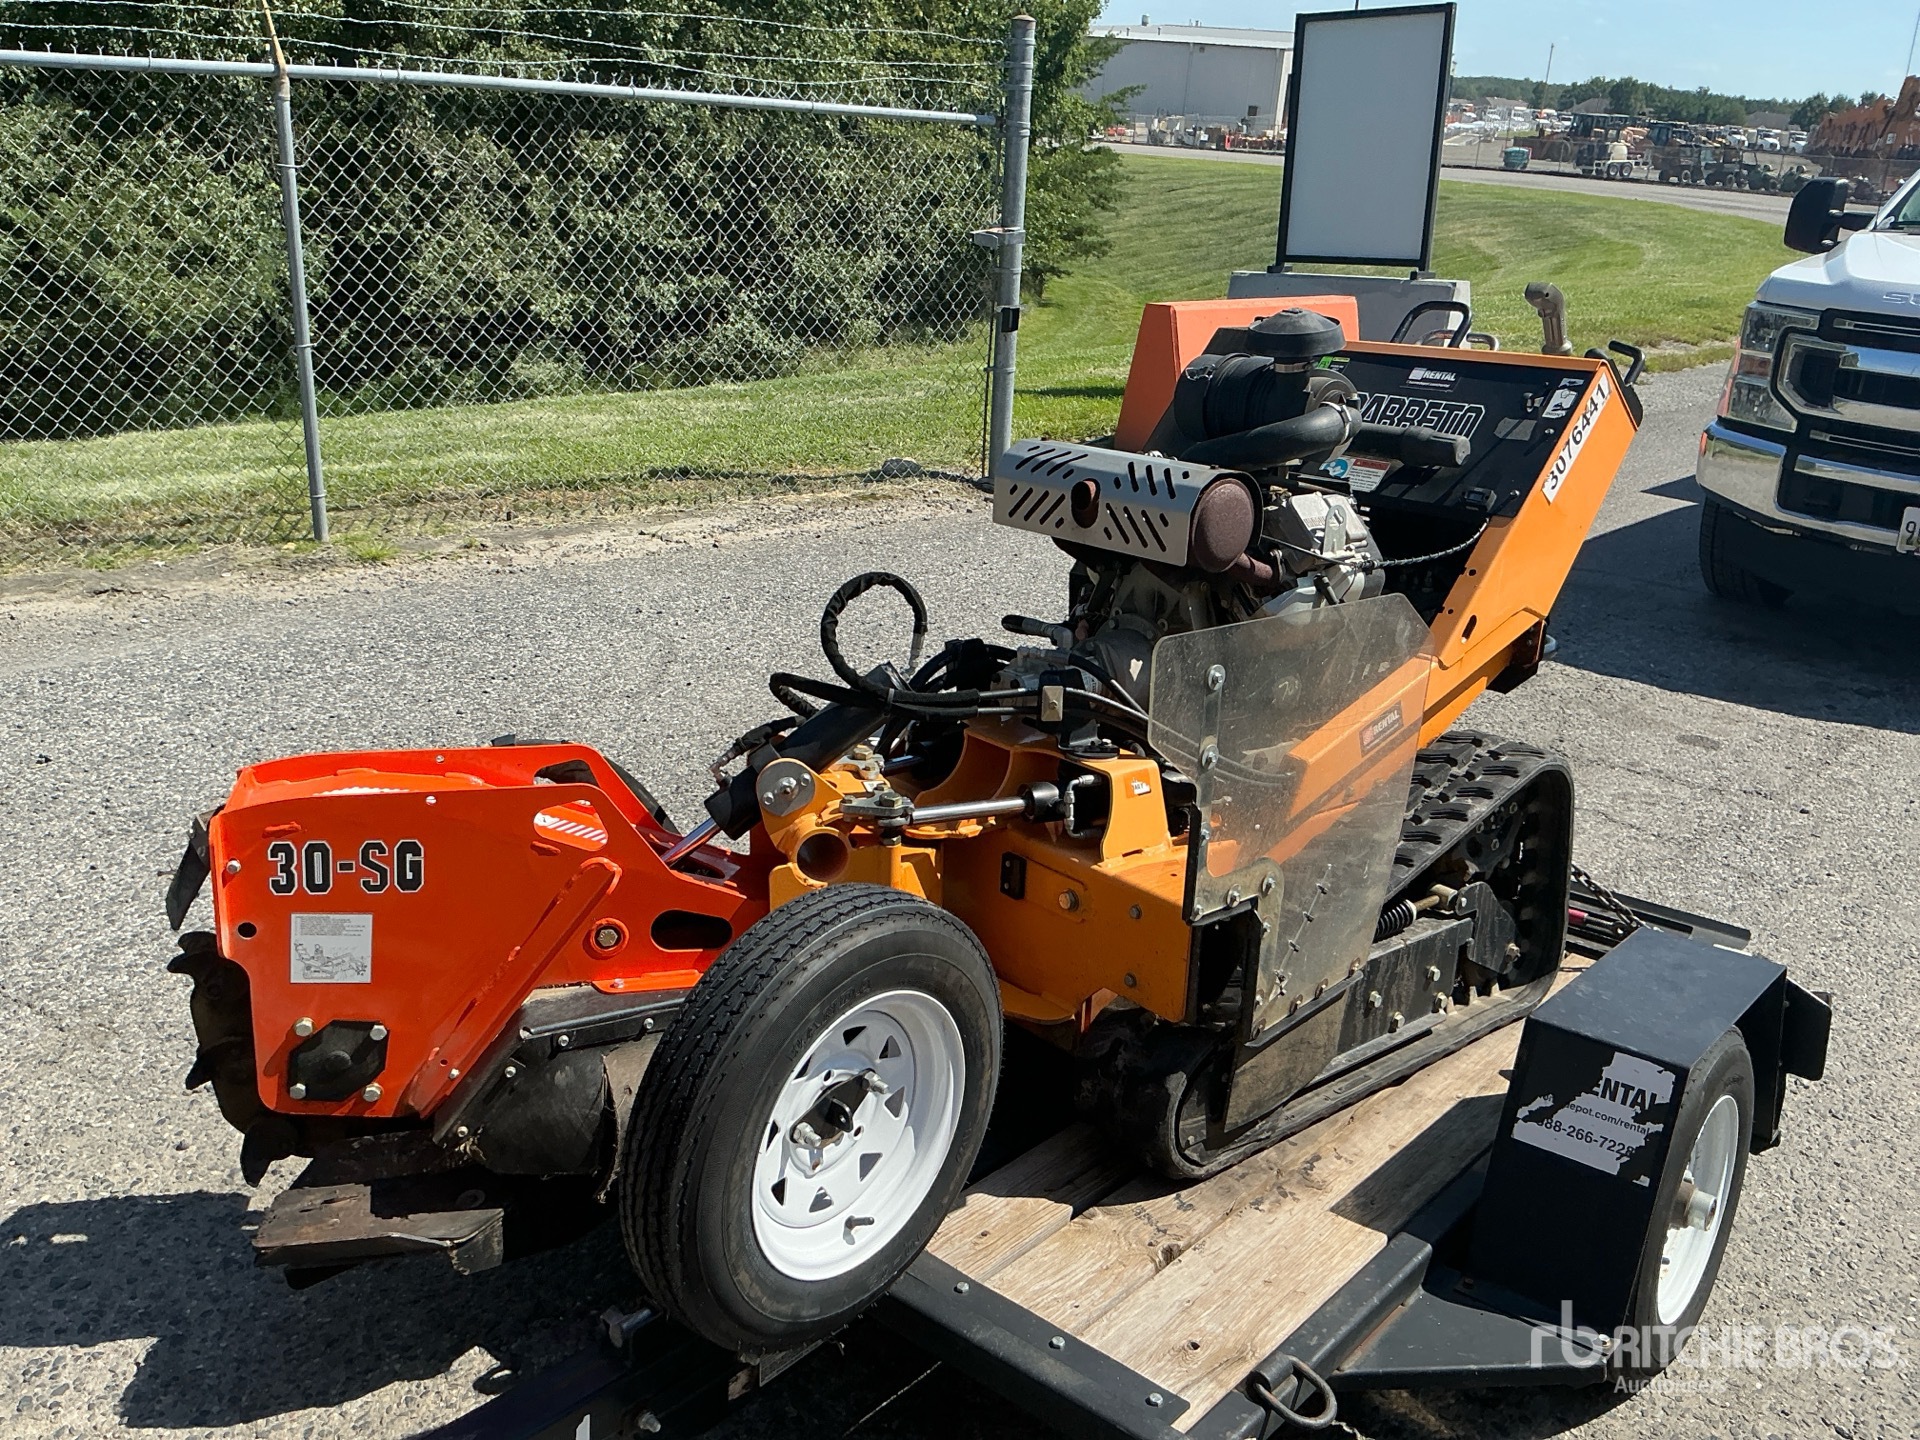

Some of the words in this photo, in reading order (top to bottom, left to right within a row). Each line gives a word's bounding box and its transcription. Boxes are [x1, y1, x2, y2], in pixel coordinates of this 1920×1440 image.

[1423, 365, 1456, 381] RENTAL
[1550, 383, 1606, 490] 3076441
[1372, 710, 1399, 735] RENTAL
[268, 840, 424, 895] 30-SG
